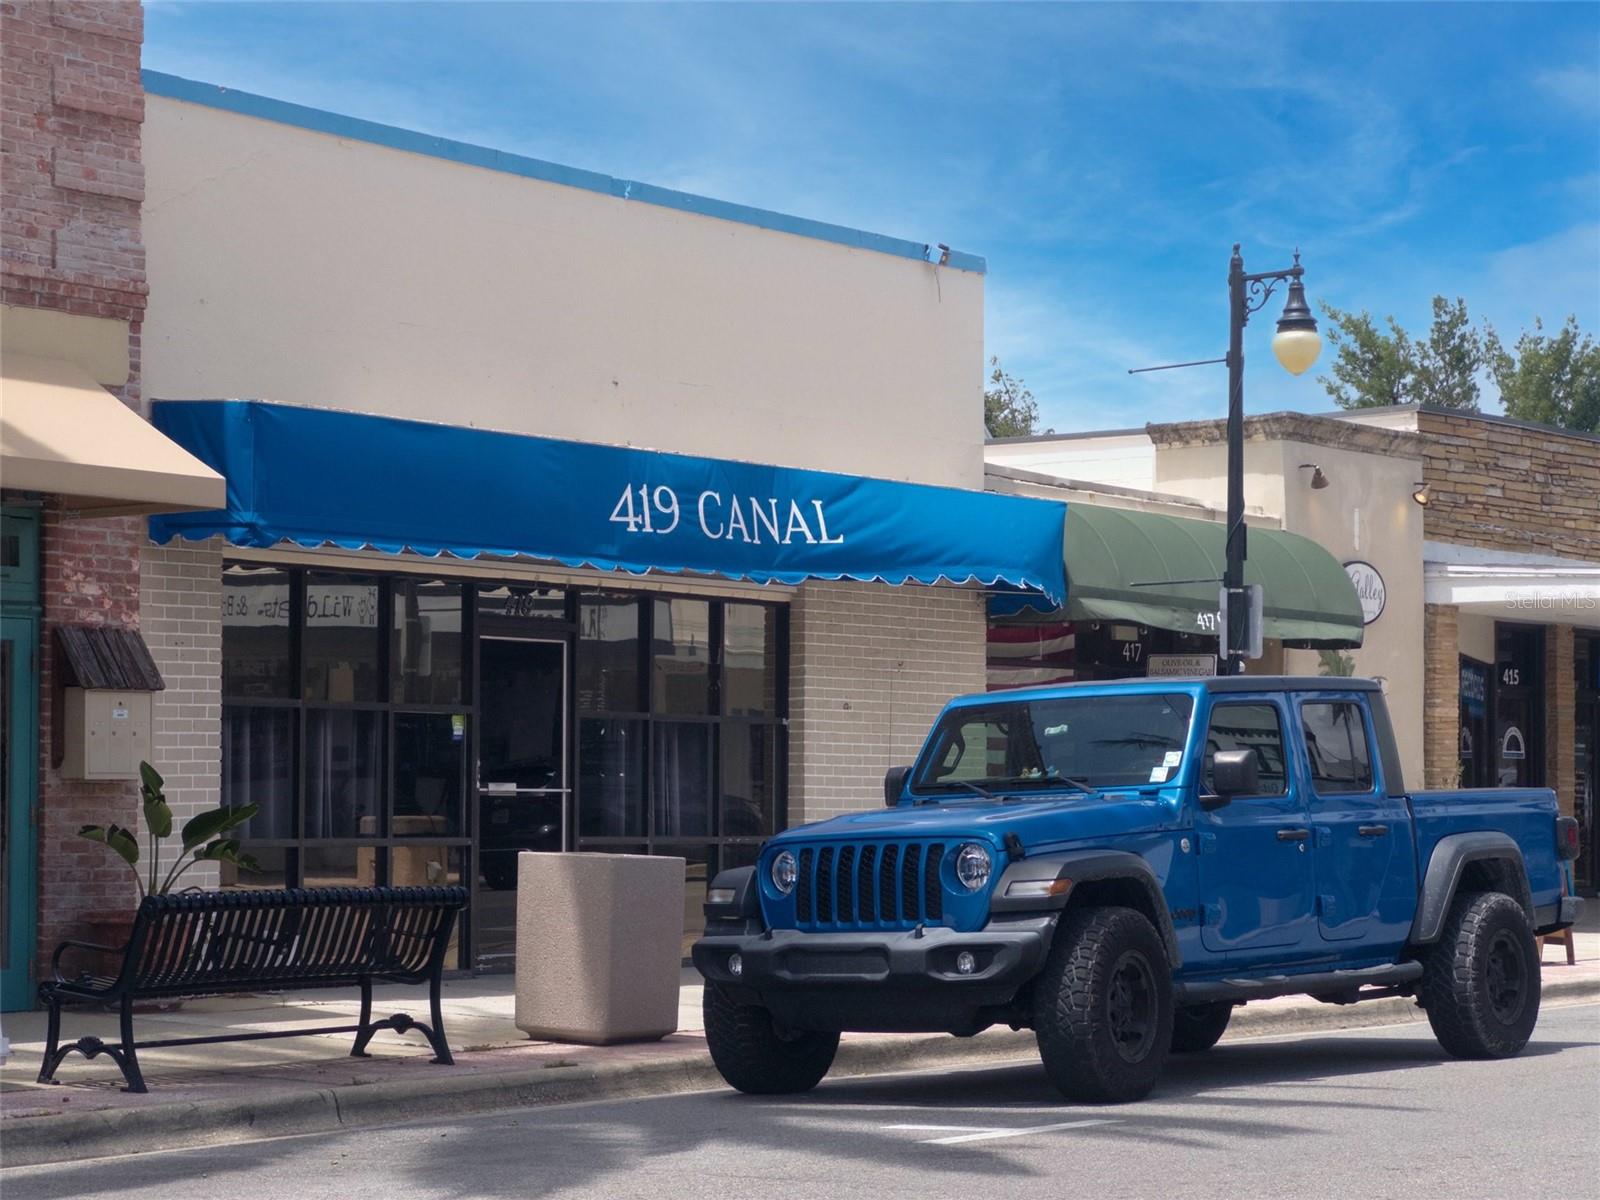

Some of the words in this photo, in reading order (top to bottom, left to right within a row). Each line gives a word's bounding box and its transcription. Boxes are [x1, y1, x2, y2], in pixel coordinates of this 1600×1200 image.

[609, 483, 680, 534] 419
[698, 490, 844, 544] CANAL
[1197, 612, 1215, 631] 417
[1122, 643, 1142, 662] 417
[1503, 668, 1520, 685] 415
